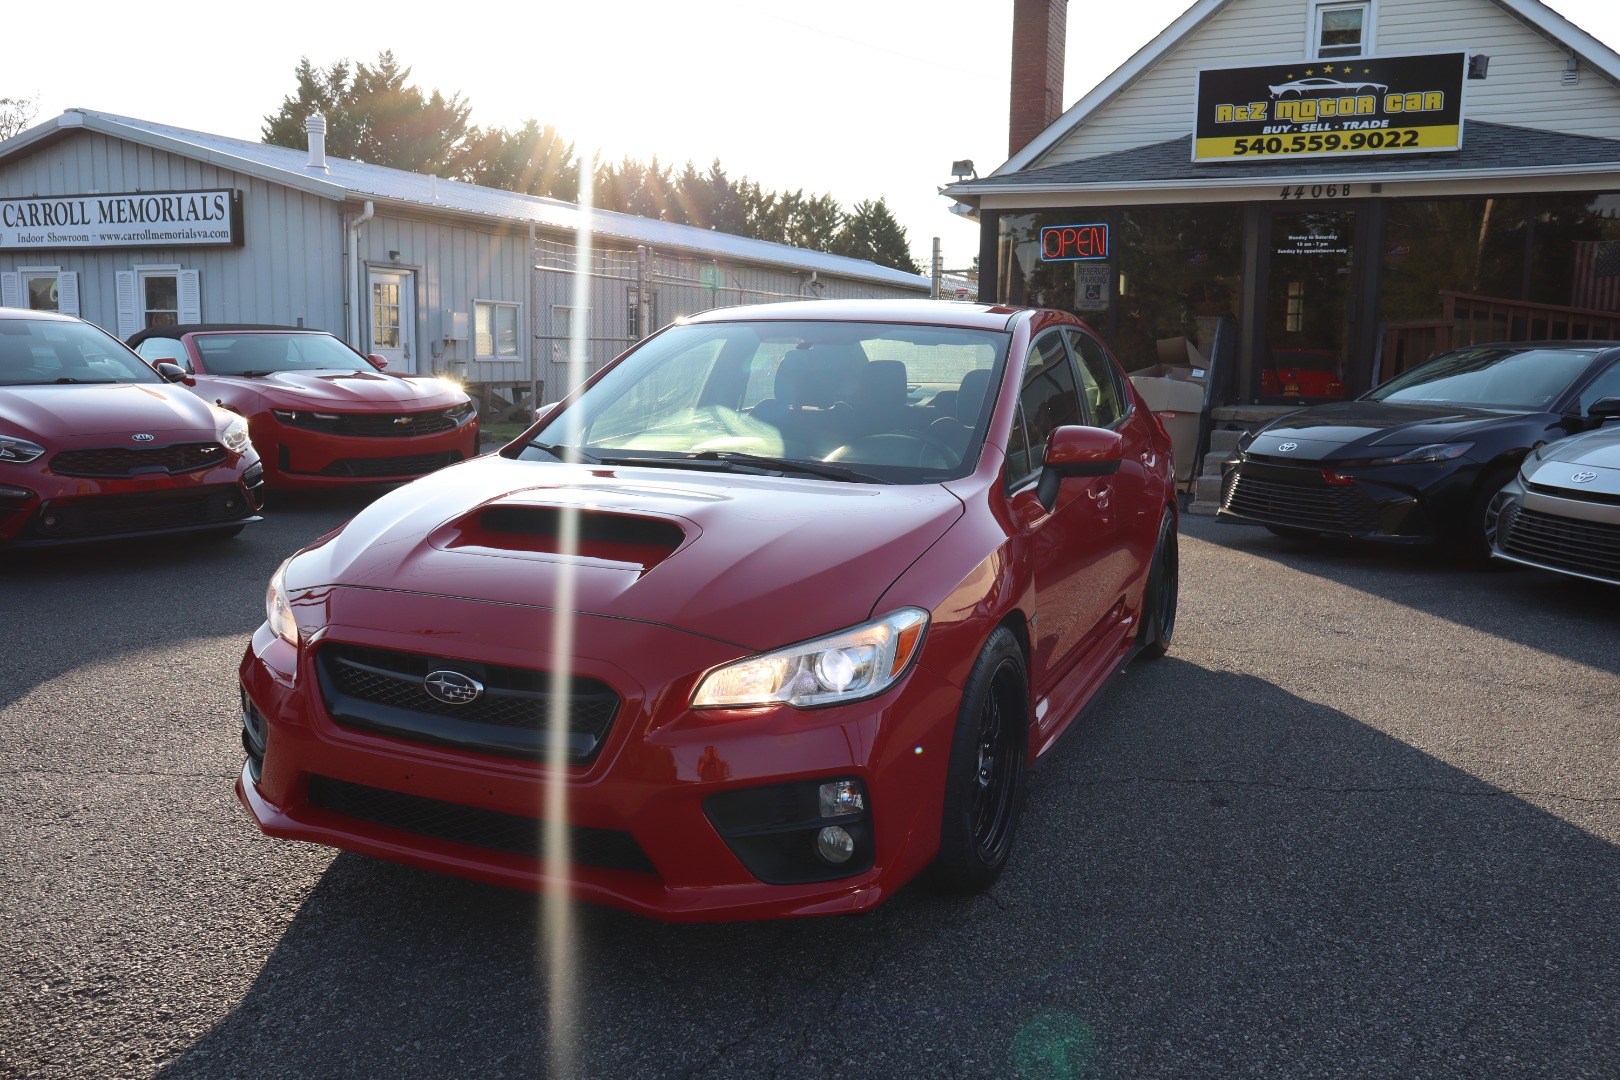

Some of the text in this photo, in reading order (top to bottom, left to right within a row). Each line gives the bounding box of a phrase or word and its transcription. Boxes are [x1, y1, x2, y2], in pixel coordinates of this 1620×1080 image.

[1262, 119, 1390, 135] BUY SELL TRADE
[1233, 130, 1419, 155] 540.559.9022
[1280, 184, 1351, 200] 4406B
[3, 195, 225, 228] CARROLL MEMORIALS
[17, 232, 44, 243] Indoor
[47, 231, 89, 243] Showroom
[99, 228, 229, 242] www.carrollmemorialsva.com
[1044, 227, 1105, 257] OPEN
[1078, 267, 1110, 276] RESERVED
[1080, 275, 1107, 284] PARKING
